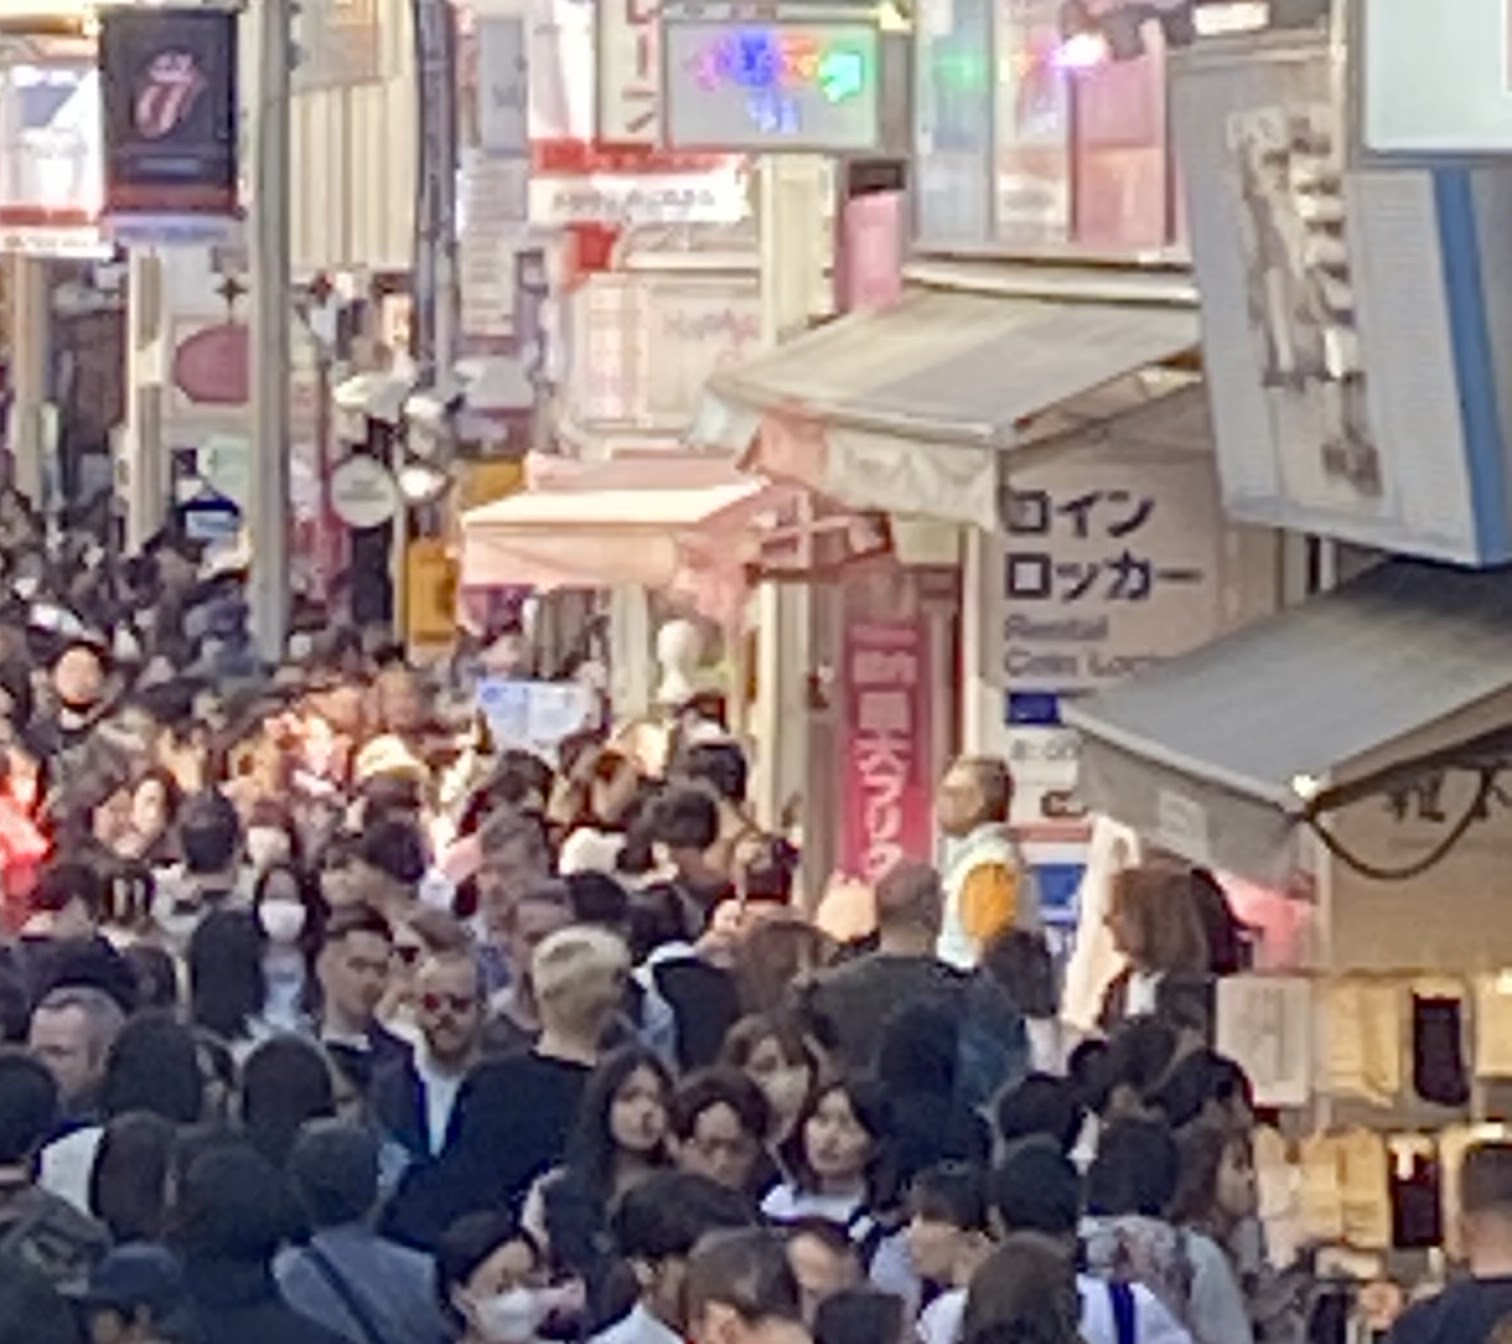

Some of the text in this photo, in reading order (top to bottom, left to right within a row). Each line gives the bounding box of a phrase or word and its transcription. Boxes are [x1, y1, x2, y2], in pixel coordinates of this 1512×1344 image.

[1004, 490, 1156, 539] コイン
[1004, 549, 1205, 602] ロッカー
